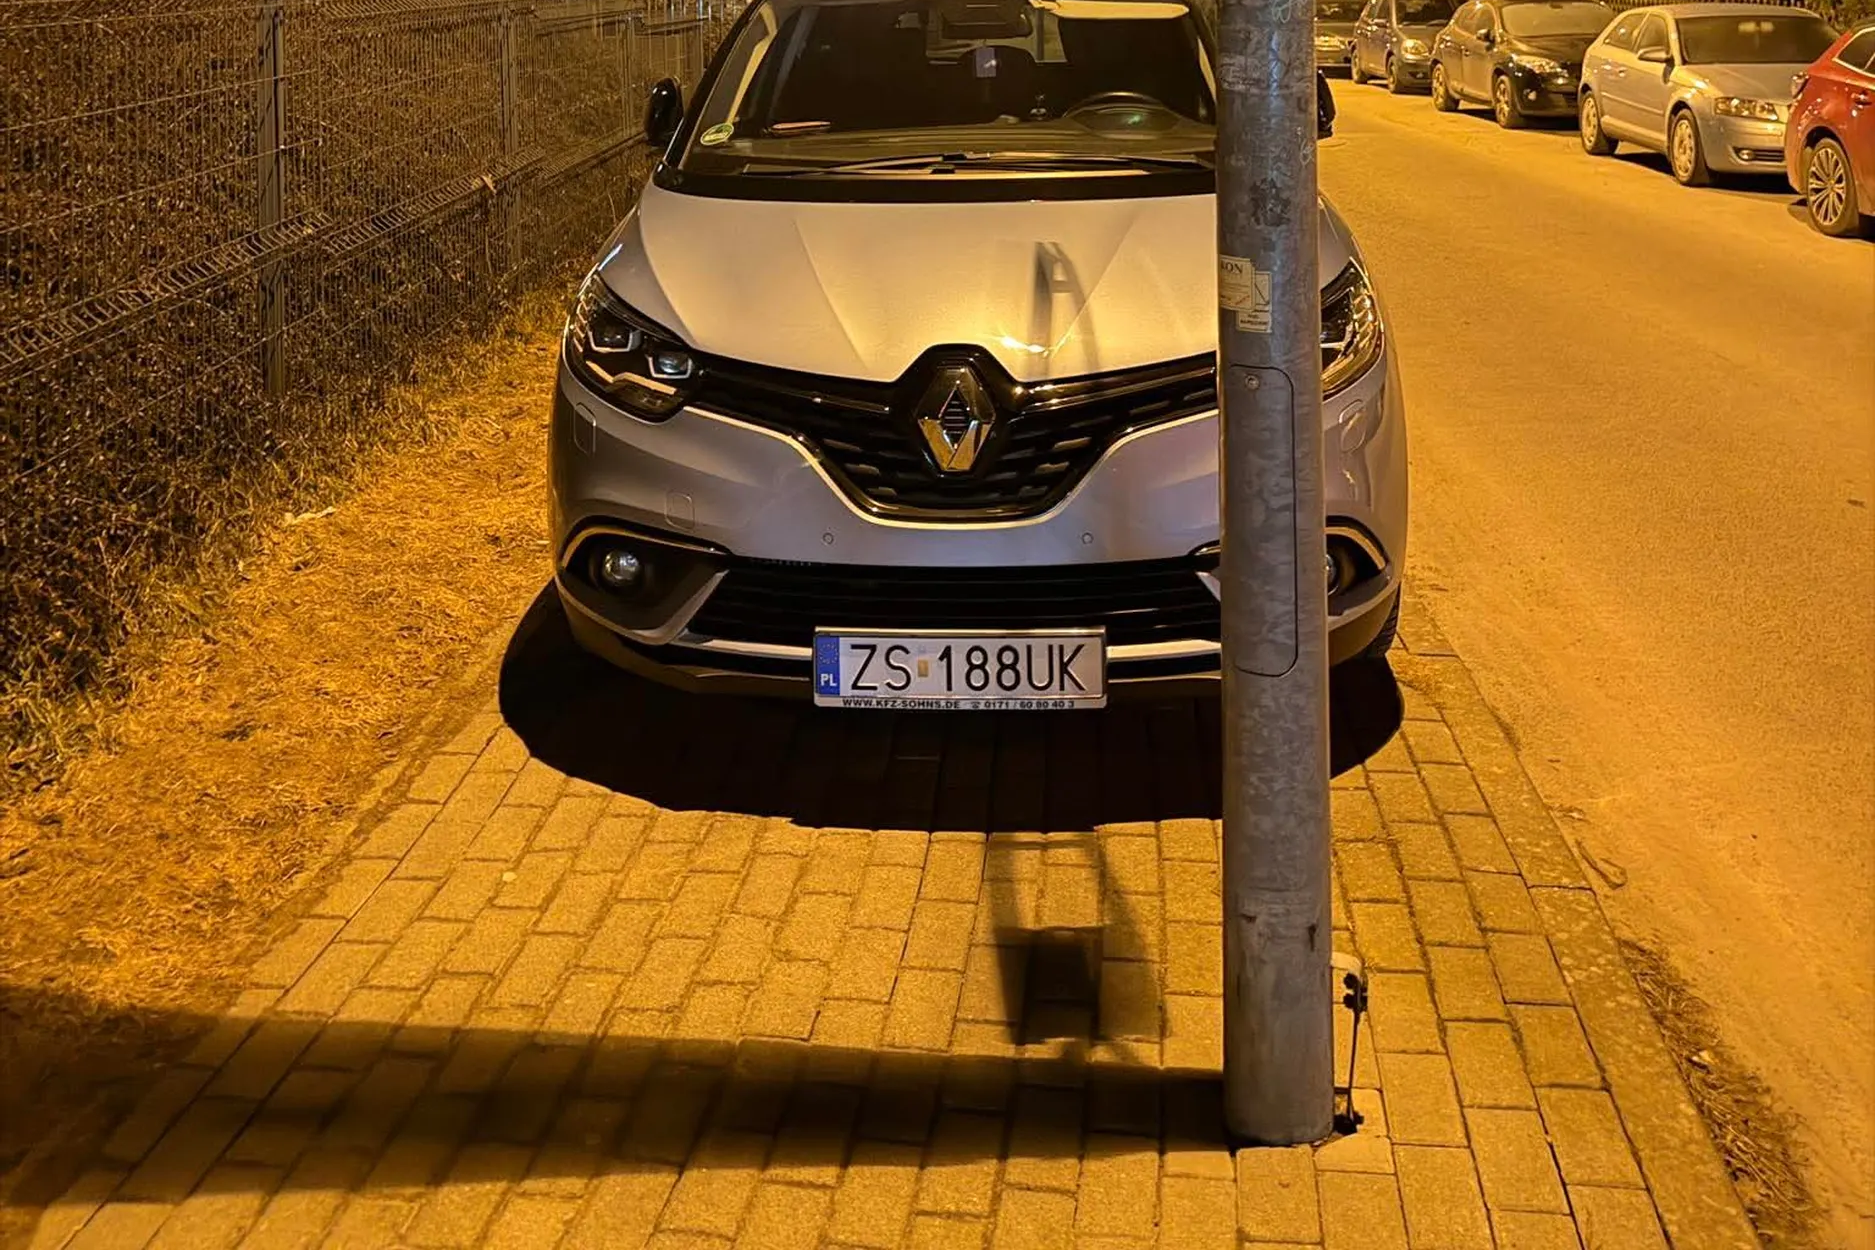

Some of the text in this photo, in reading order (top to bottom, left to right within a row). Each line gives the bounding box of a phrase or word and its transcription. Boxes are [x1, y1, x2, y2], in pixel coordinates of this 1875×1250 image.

[820, 674, 837, 687] PL
[850, 644, 1087, 692] ZS 188UK
